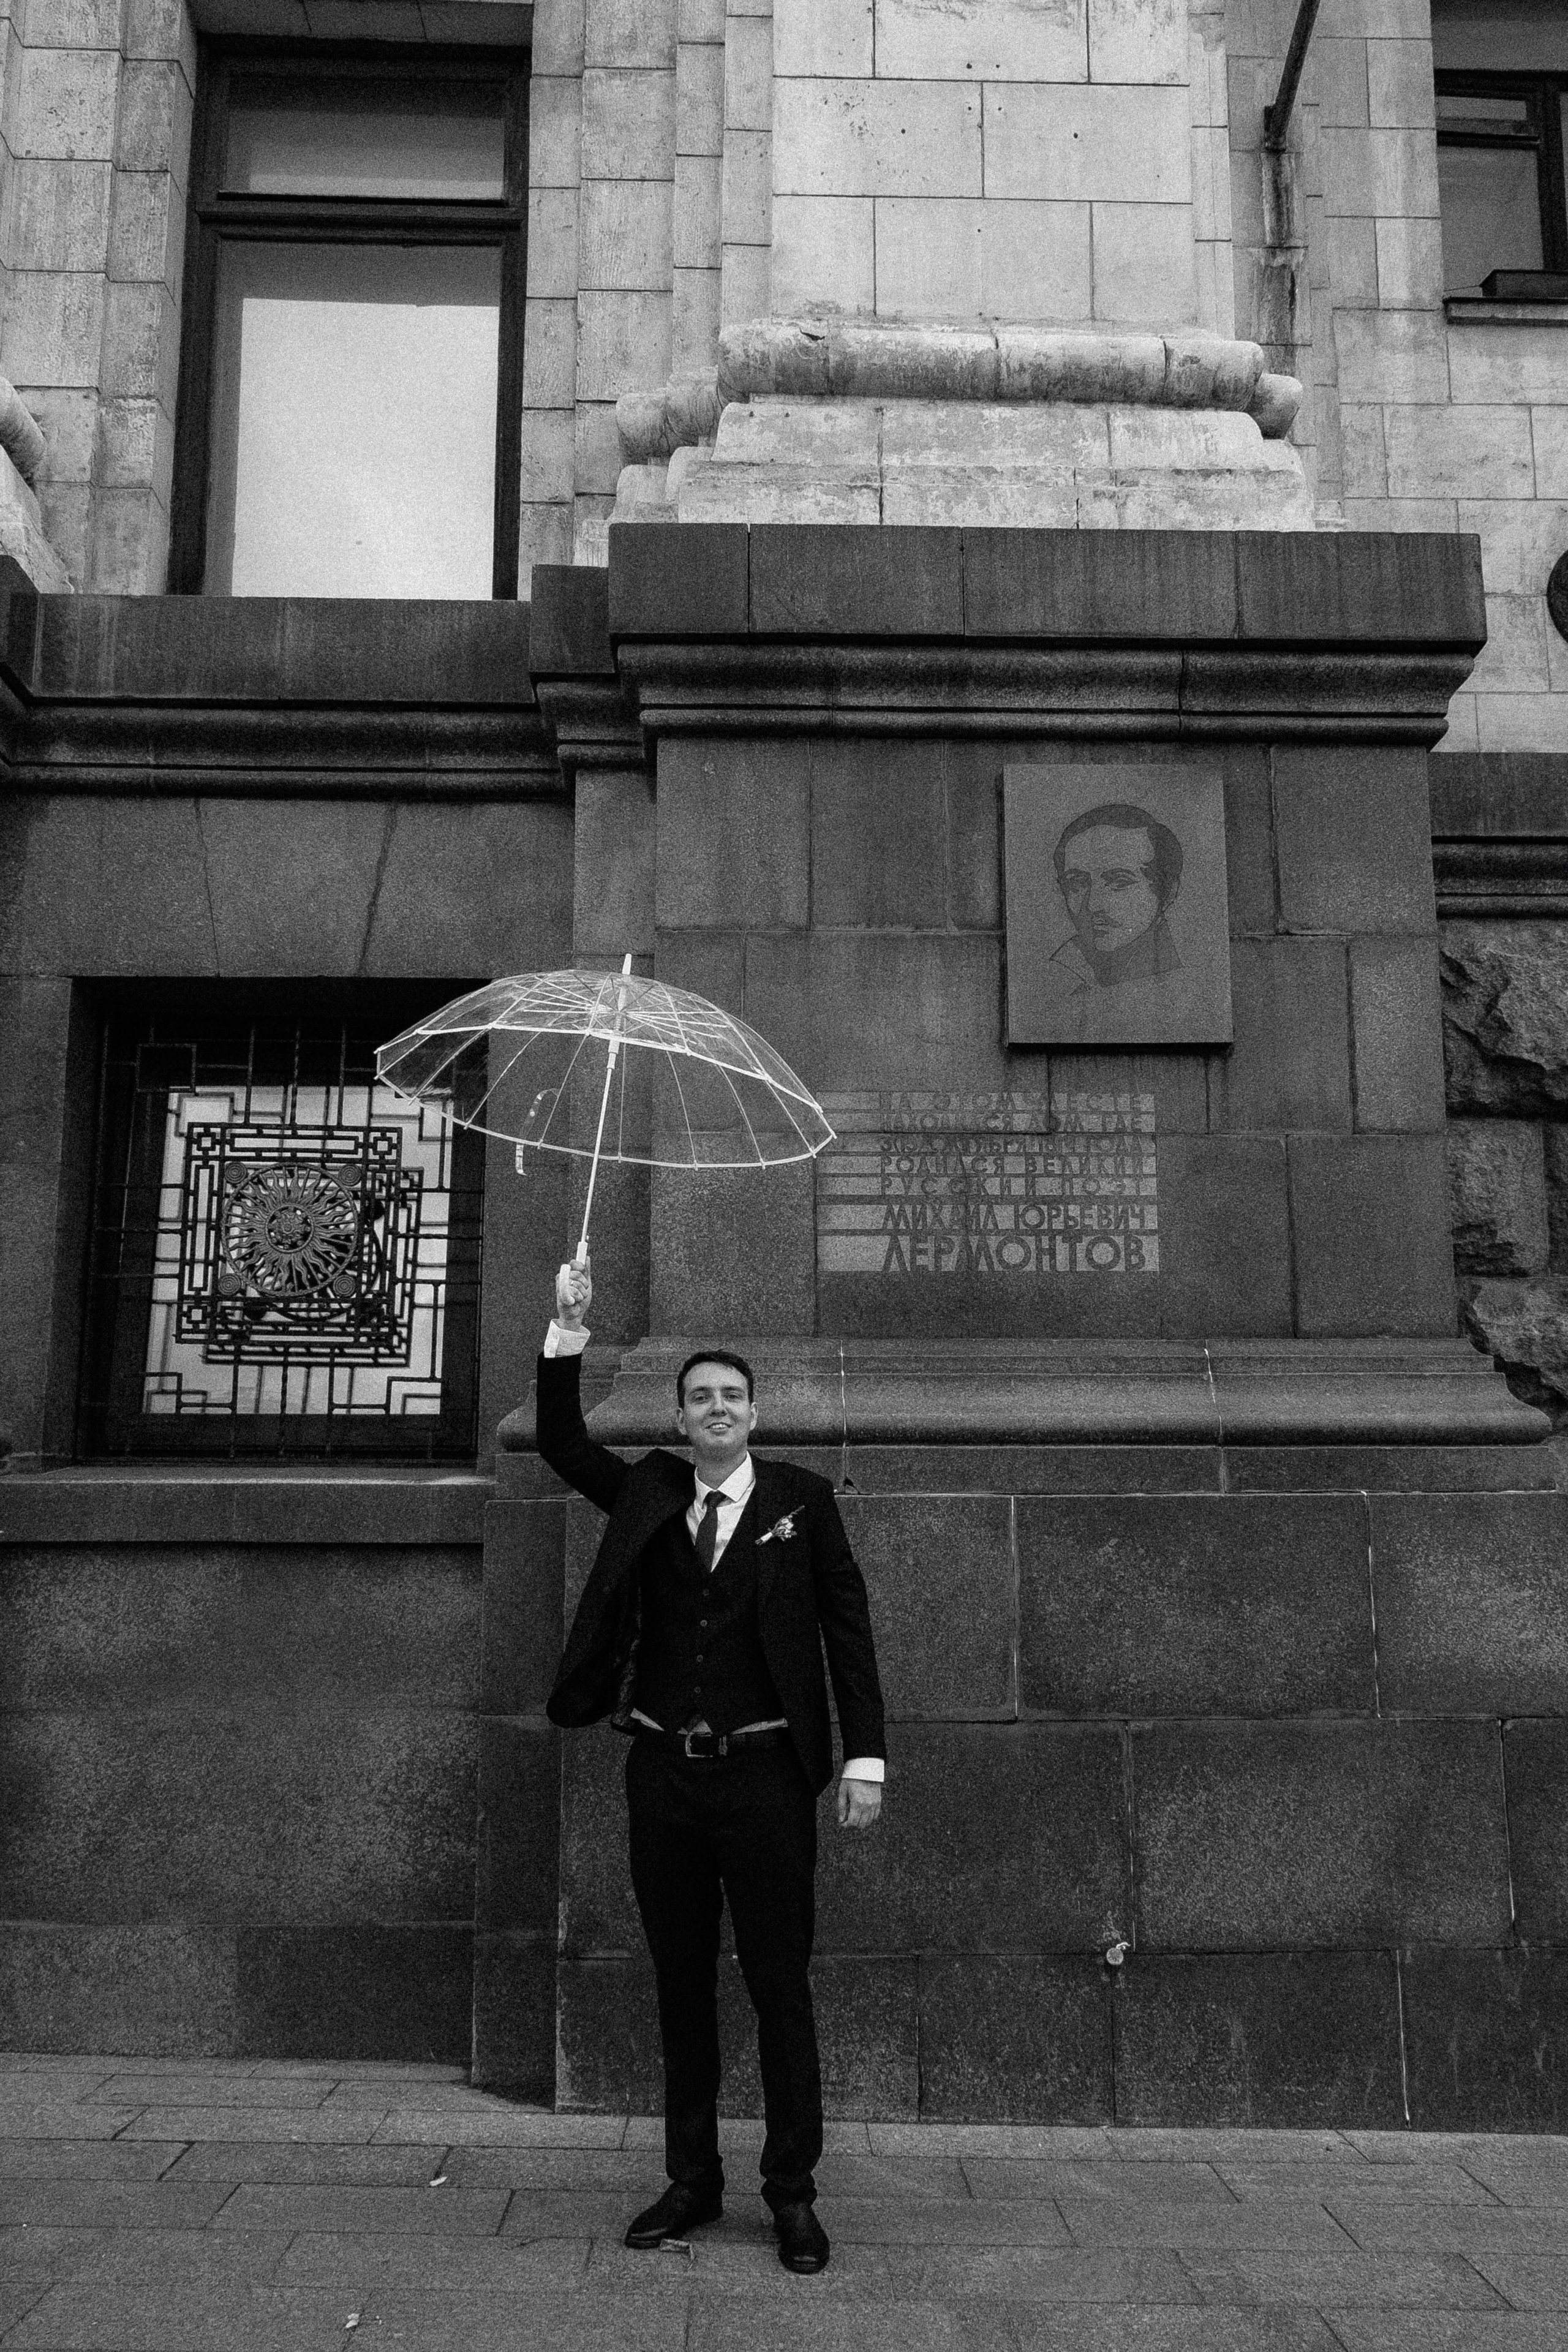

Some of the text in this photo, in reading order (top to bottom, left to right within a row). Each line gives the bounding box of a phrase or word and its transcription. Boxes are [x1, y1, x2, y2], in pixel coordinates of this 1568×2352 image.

[880, 1156, 1005, 1174] РОДИЛСЯ
[1061, 1177, 1144, 1196] ПОЭТ
[883, 1204, 1145, 1230] МИХАИЛ ЮРЬЕВИЧ
[881, 1235, 1147, 1272] ЛЕРМОНТОВ
